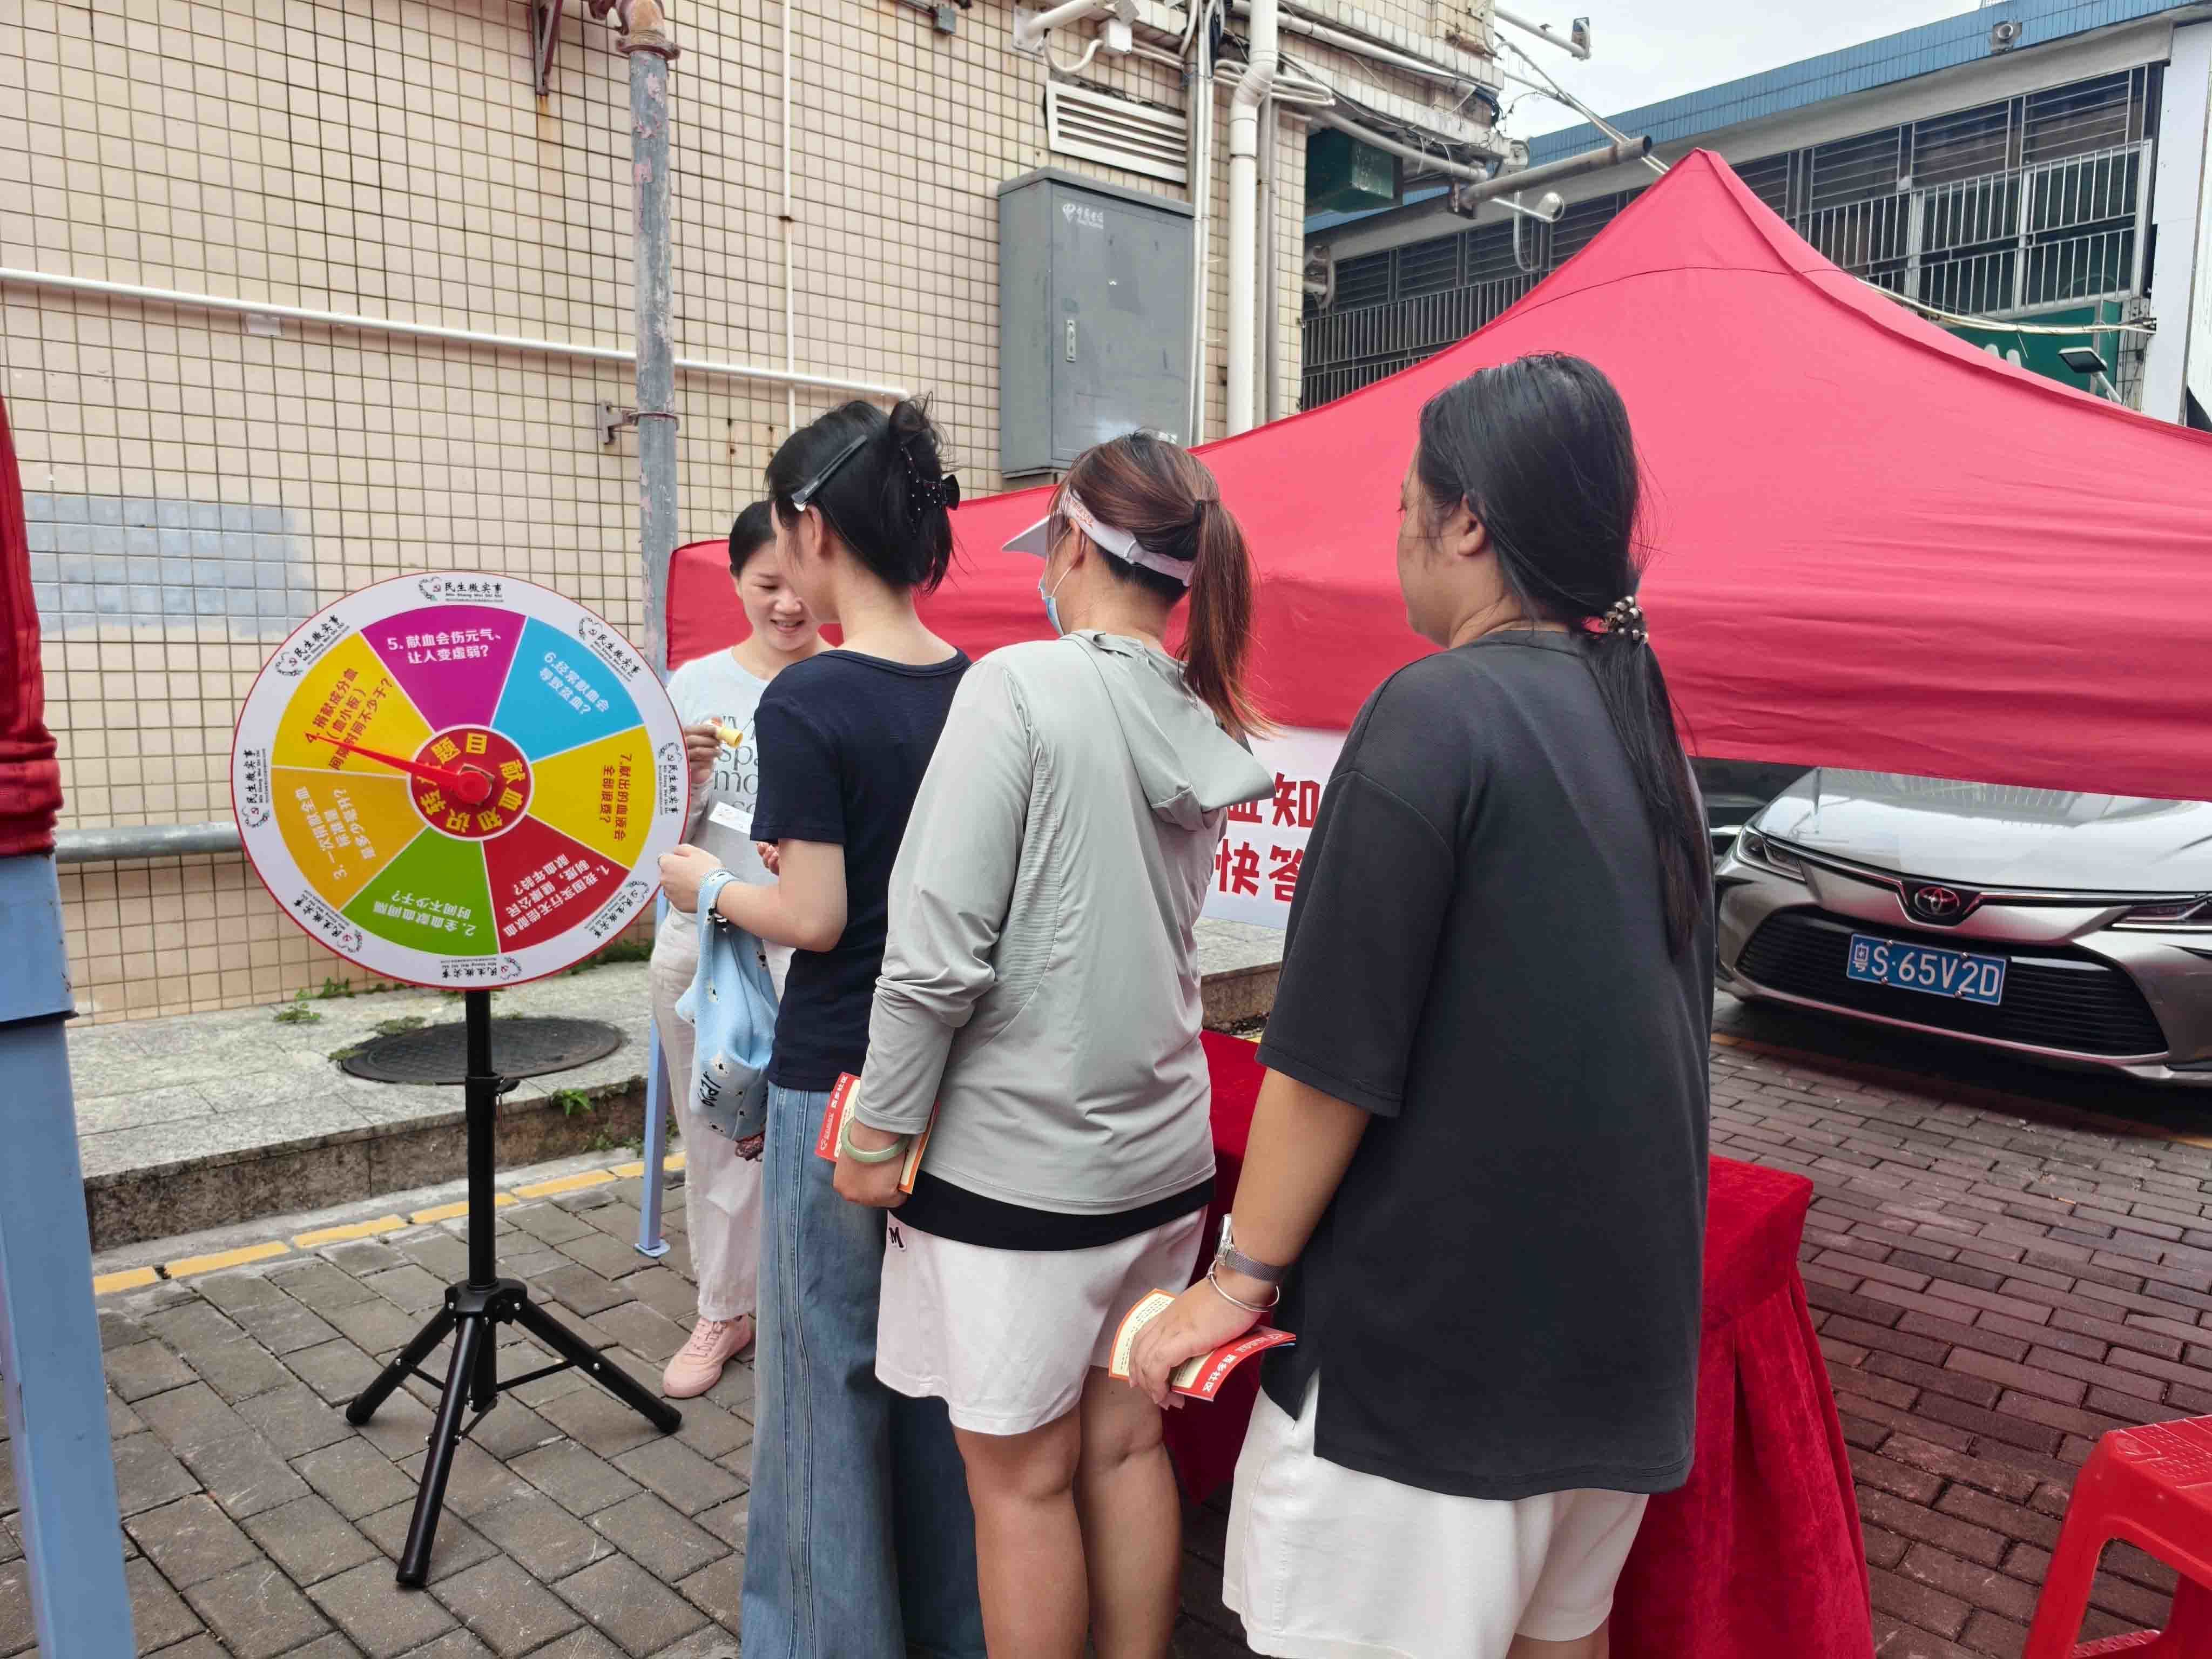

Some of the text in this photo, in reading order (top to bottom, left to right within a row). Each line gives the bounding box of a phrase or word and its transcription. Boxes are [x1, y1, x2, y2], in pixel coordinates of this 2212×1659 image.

[445, 581, 502, 594] 民生微实事
[1215, 839, 1304, 902] 快答
[889, 1227, 904, 1248] M
